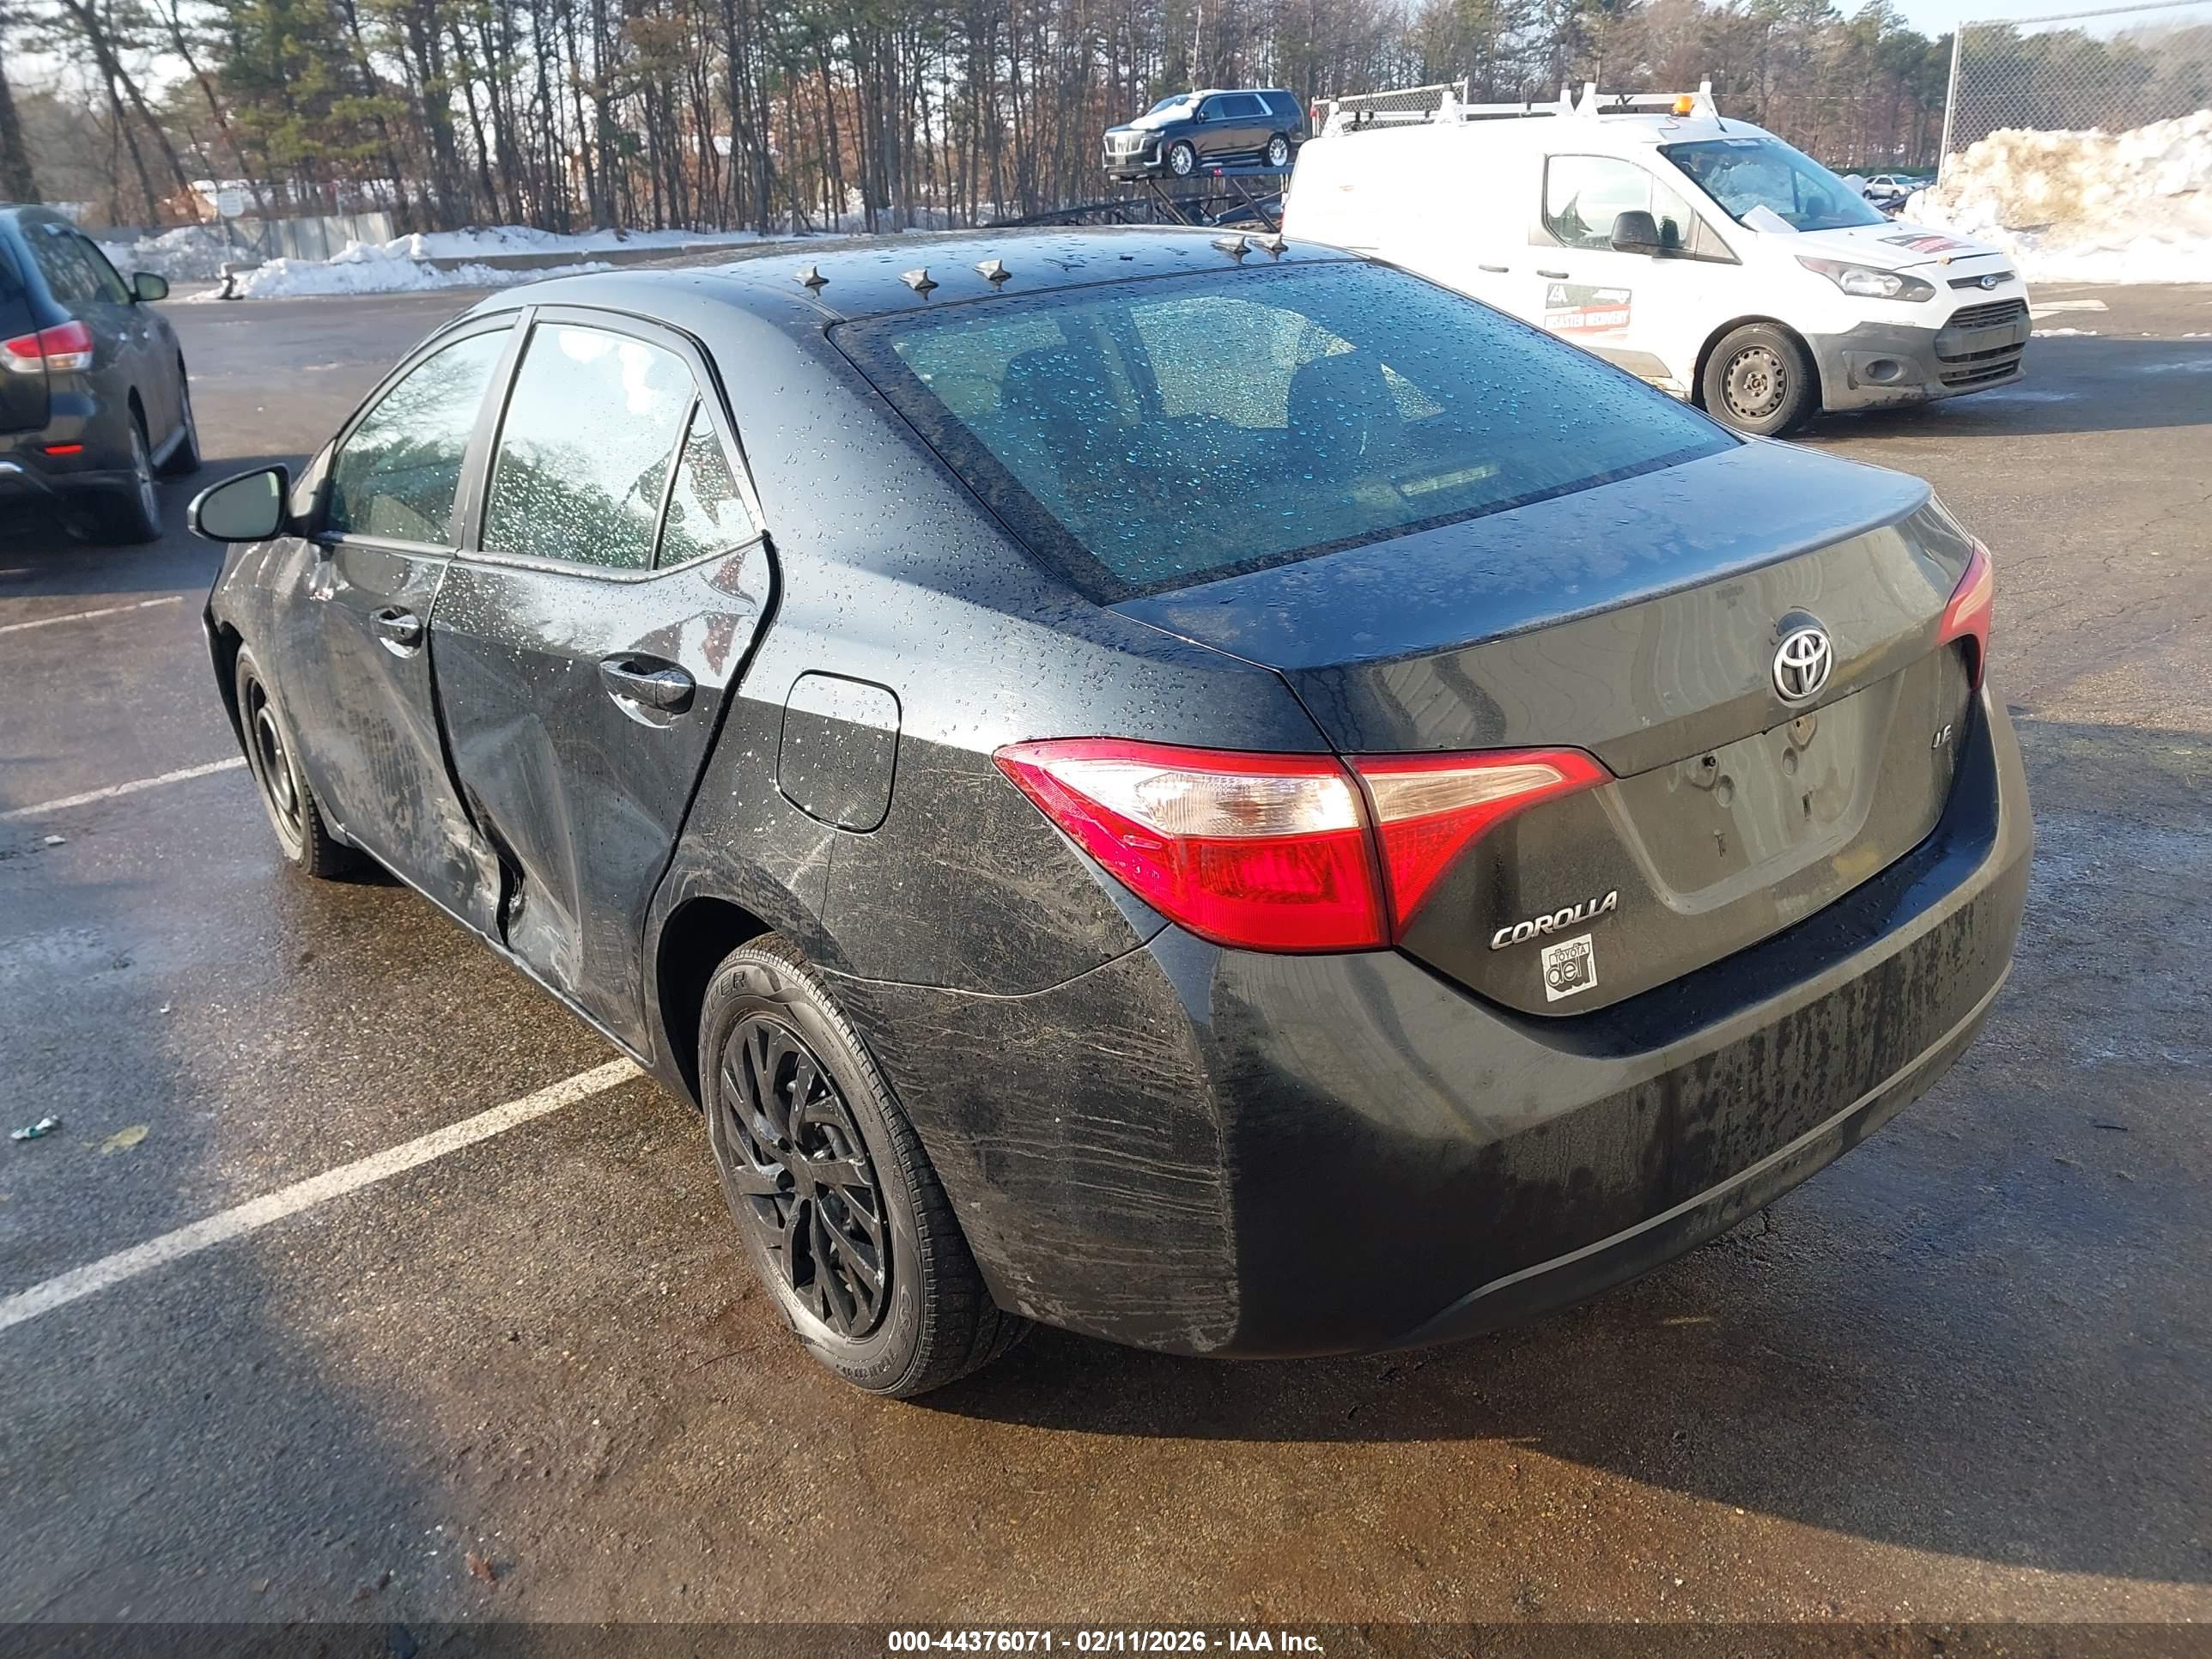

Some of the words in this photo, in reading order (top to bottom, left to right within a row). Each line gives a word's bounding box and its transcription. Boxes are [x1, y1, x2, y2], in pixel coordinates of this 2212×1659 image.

[1932, 724, 1952, 749] LE
[1491, 890, 1618, 951] COROLLA
[1554, 945, 1587, 963] TOYOTA
